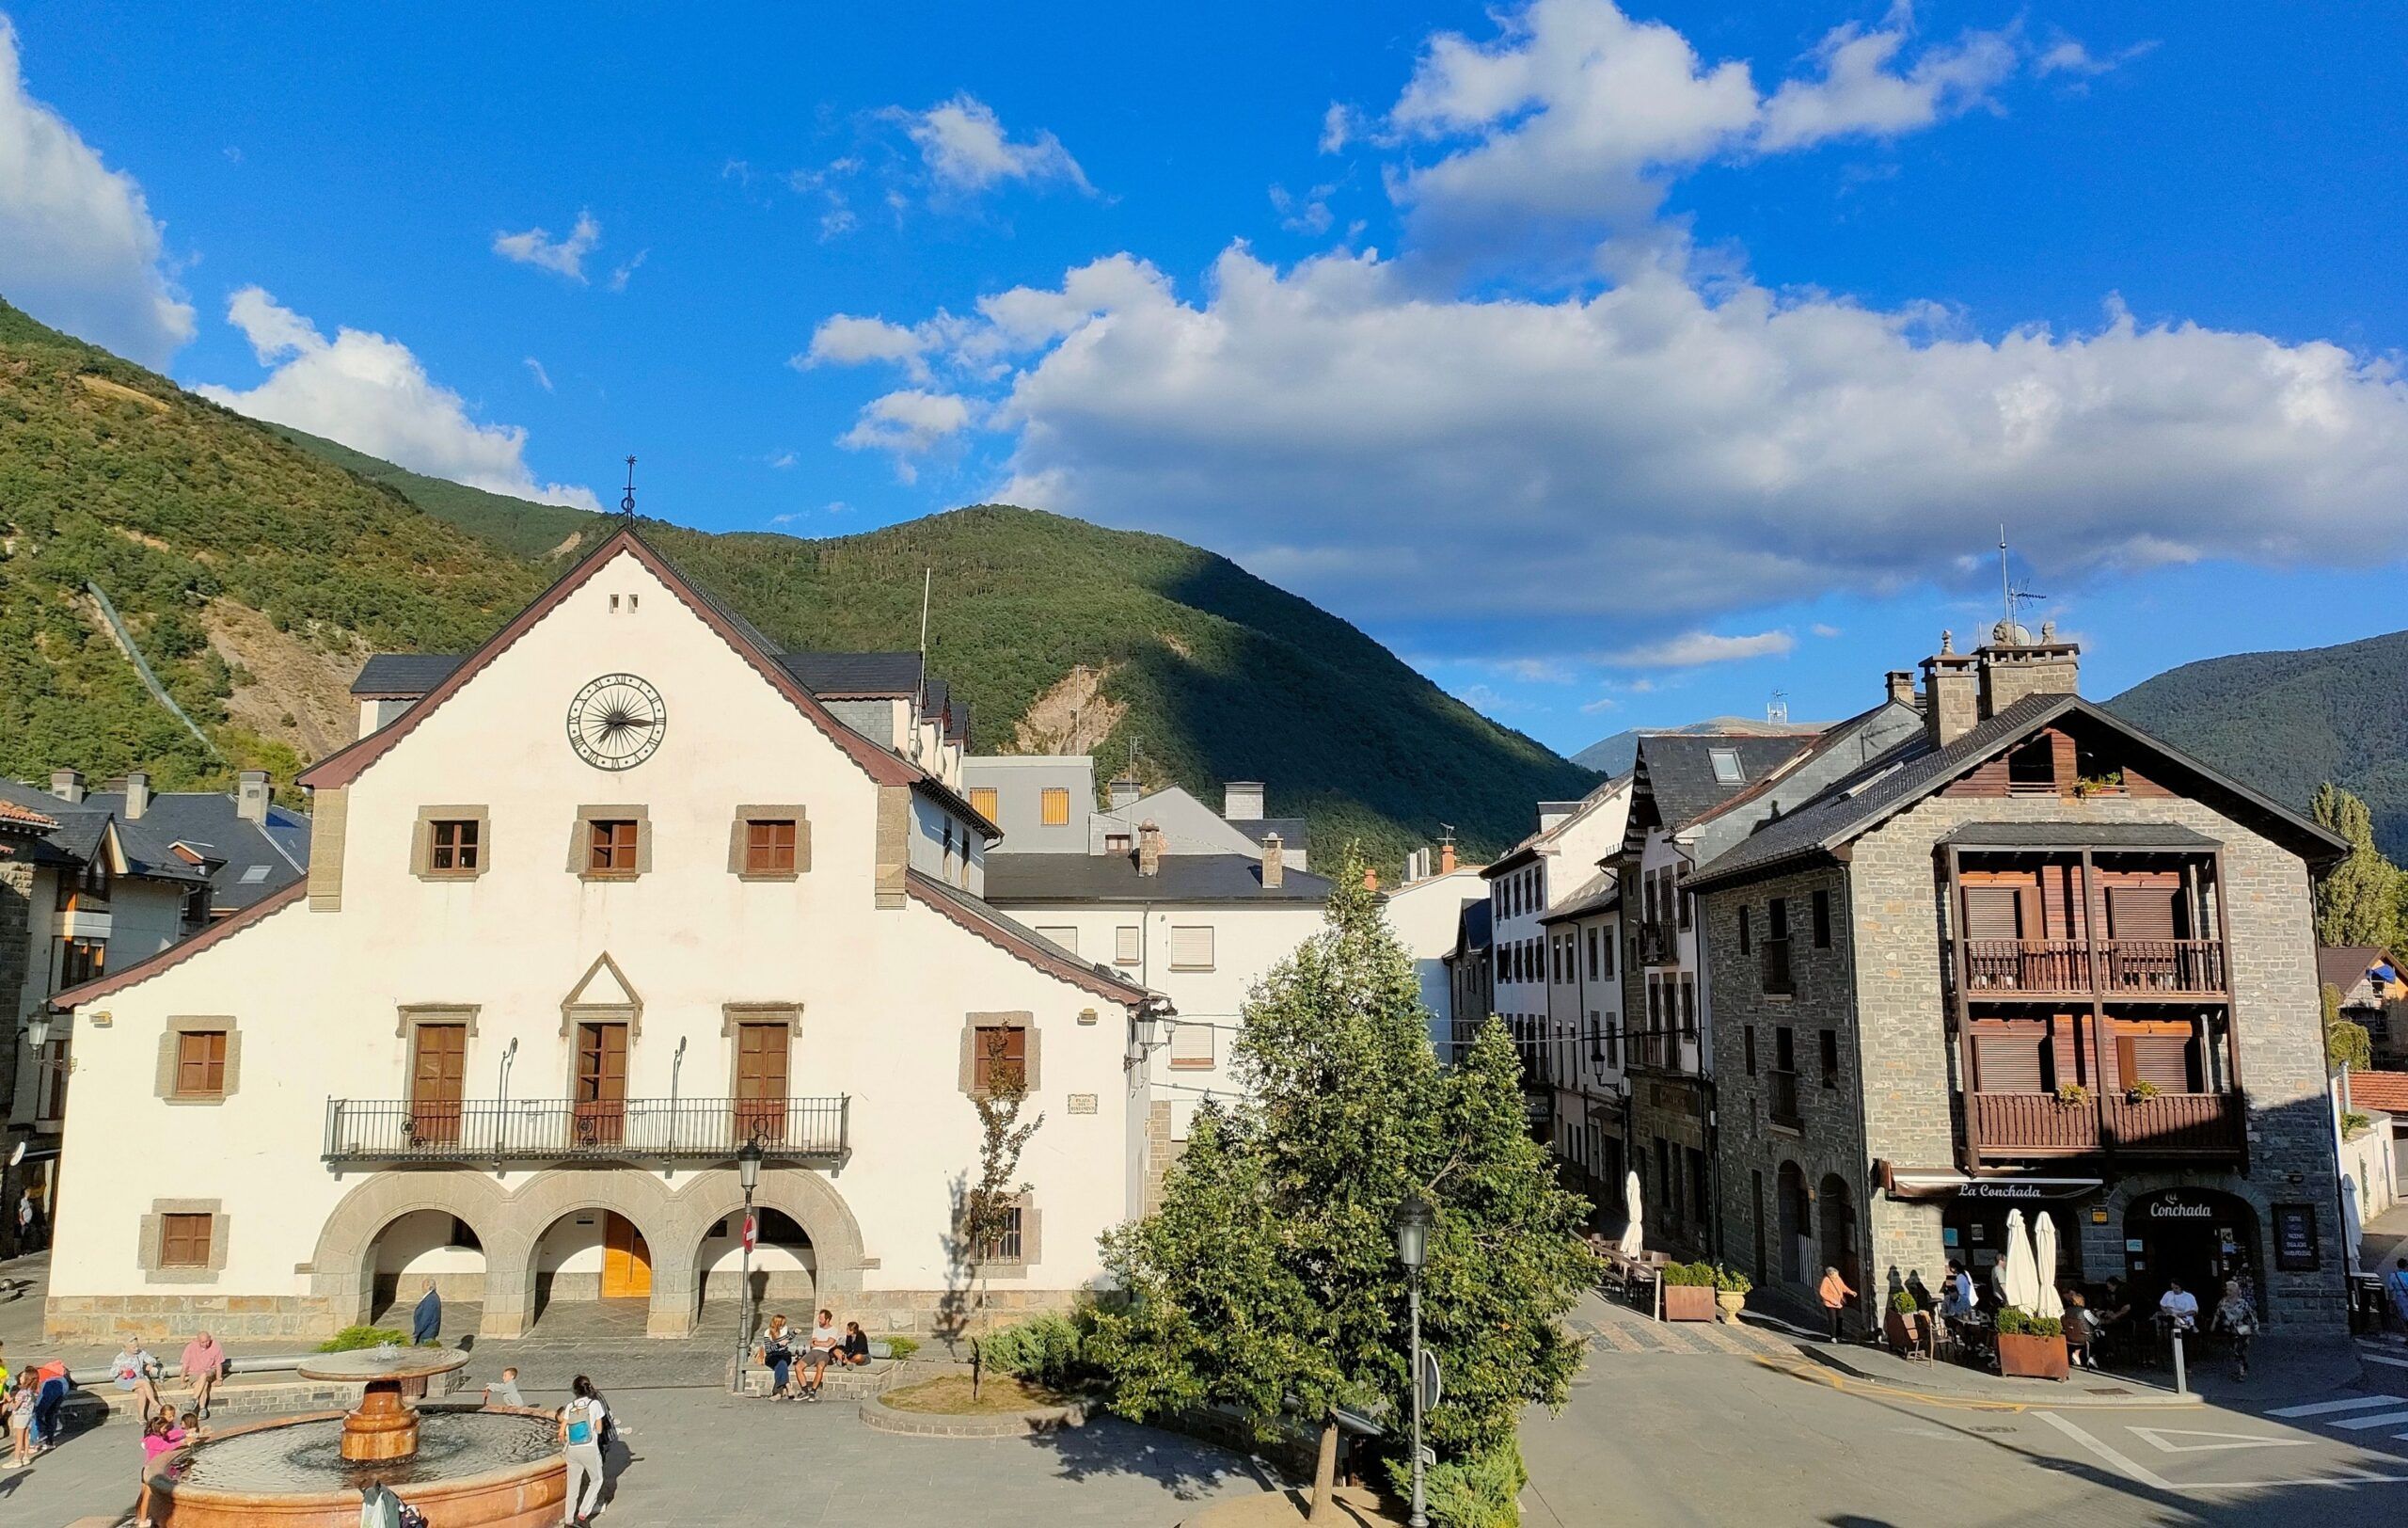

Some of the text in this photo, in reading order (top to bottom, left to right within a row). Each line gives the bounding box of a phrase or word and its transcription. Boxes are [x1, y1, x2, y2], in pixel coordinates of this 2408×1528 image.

[614, 675, 626, 685] XII
[575, 694, 588, 705] X
[1958, 1184, 2042, 1198] La Conchada
[2150, 1202, 2212, 1218] Conchada
